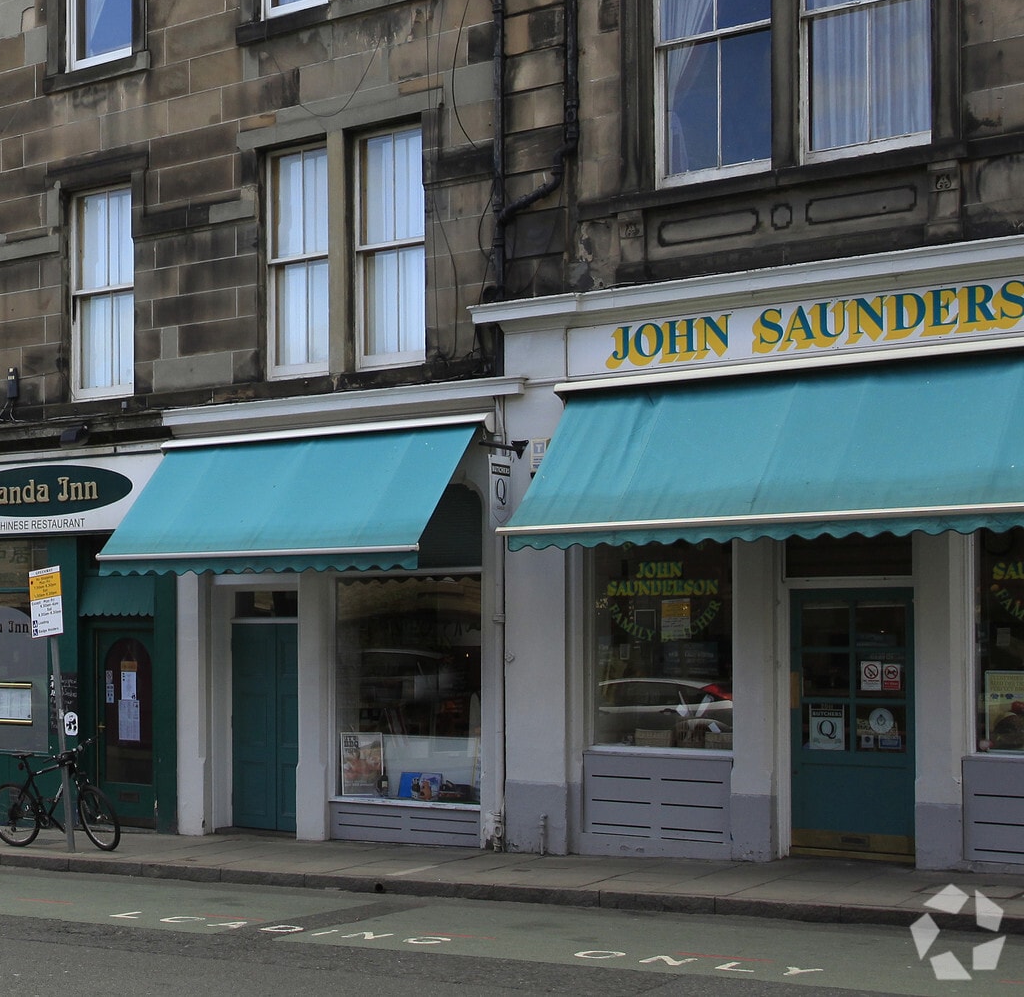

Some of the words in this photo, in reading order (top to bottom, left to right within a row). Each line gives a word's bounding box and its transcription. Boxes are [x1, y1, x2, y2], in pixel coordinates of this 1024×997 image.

[605, 312, 732, 369] JOHN
[752, 280, 1024, 355] SAUNDERS
[57, 476, 99, 502] Inn
[31, 518, 86, 530] RESTAURANT
[636, 561, 683, 578] JOHN
[607, 579, 719, 596] SAUNDERSON
[8, 620, 29, 633] Inn
[608, 603, 655, 642] FAMILY
[819, 719, 836, 739] Q
[109, 911, 452, 944] LOADING
[574, 950, 824, 976] ONLY
